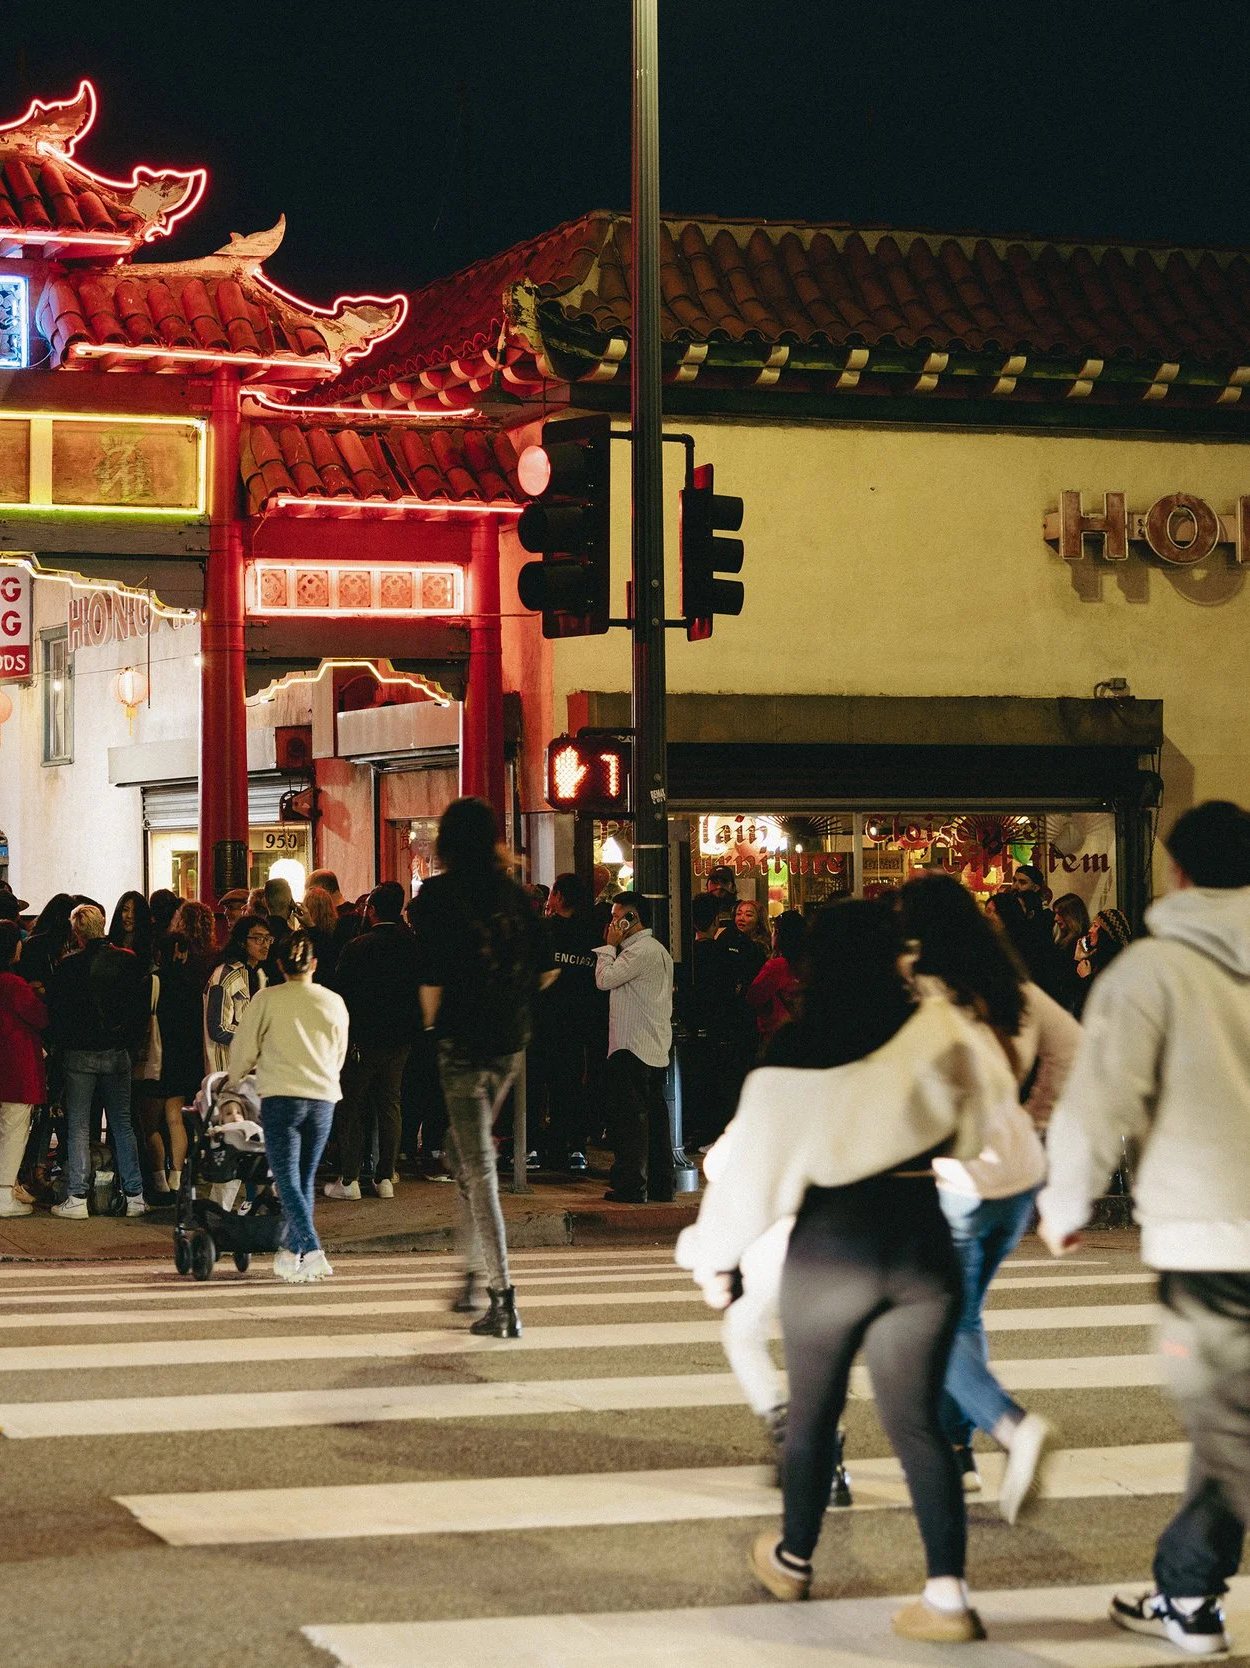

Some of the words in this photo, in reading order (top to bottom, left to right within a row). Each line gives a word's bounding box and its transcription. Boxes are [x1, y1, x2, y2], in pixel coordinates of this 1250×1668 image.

[67, 588, 155, 653] HONG
[265, 833, 298, 850] 950
[691, 843, 847, 877] urniture
